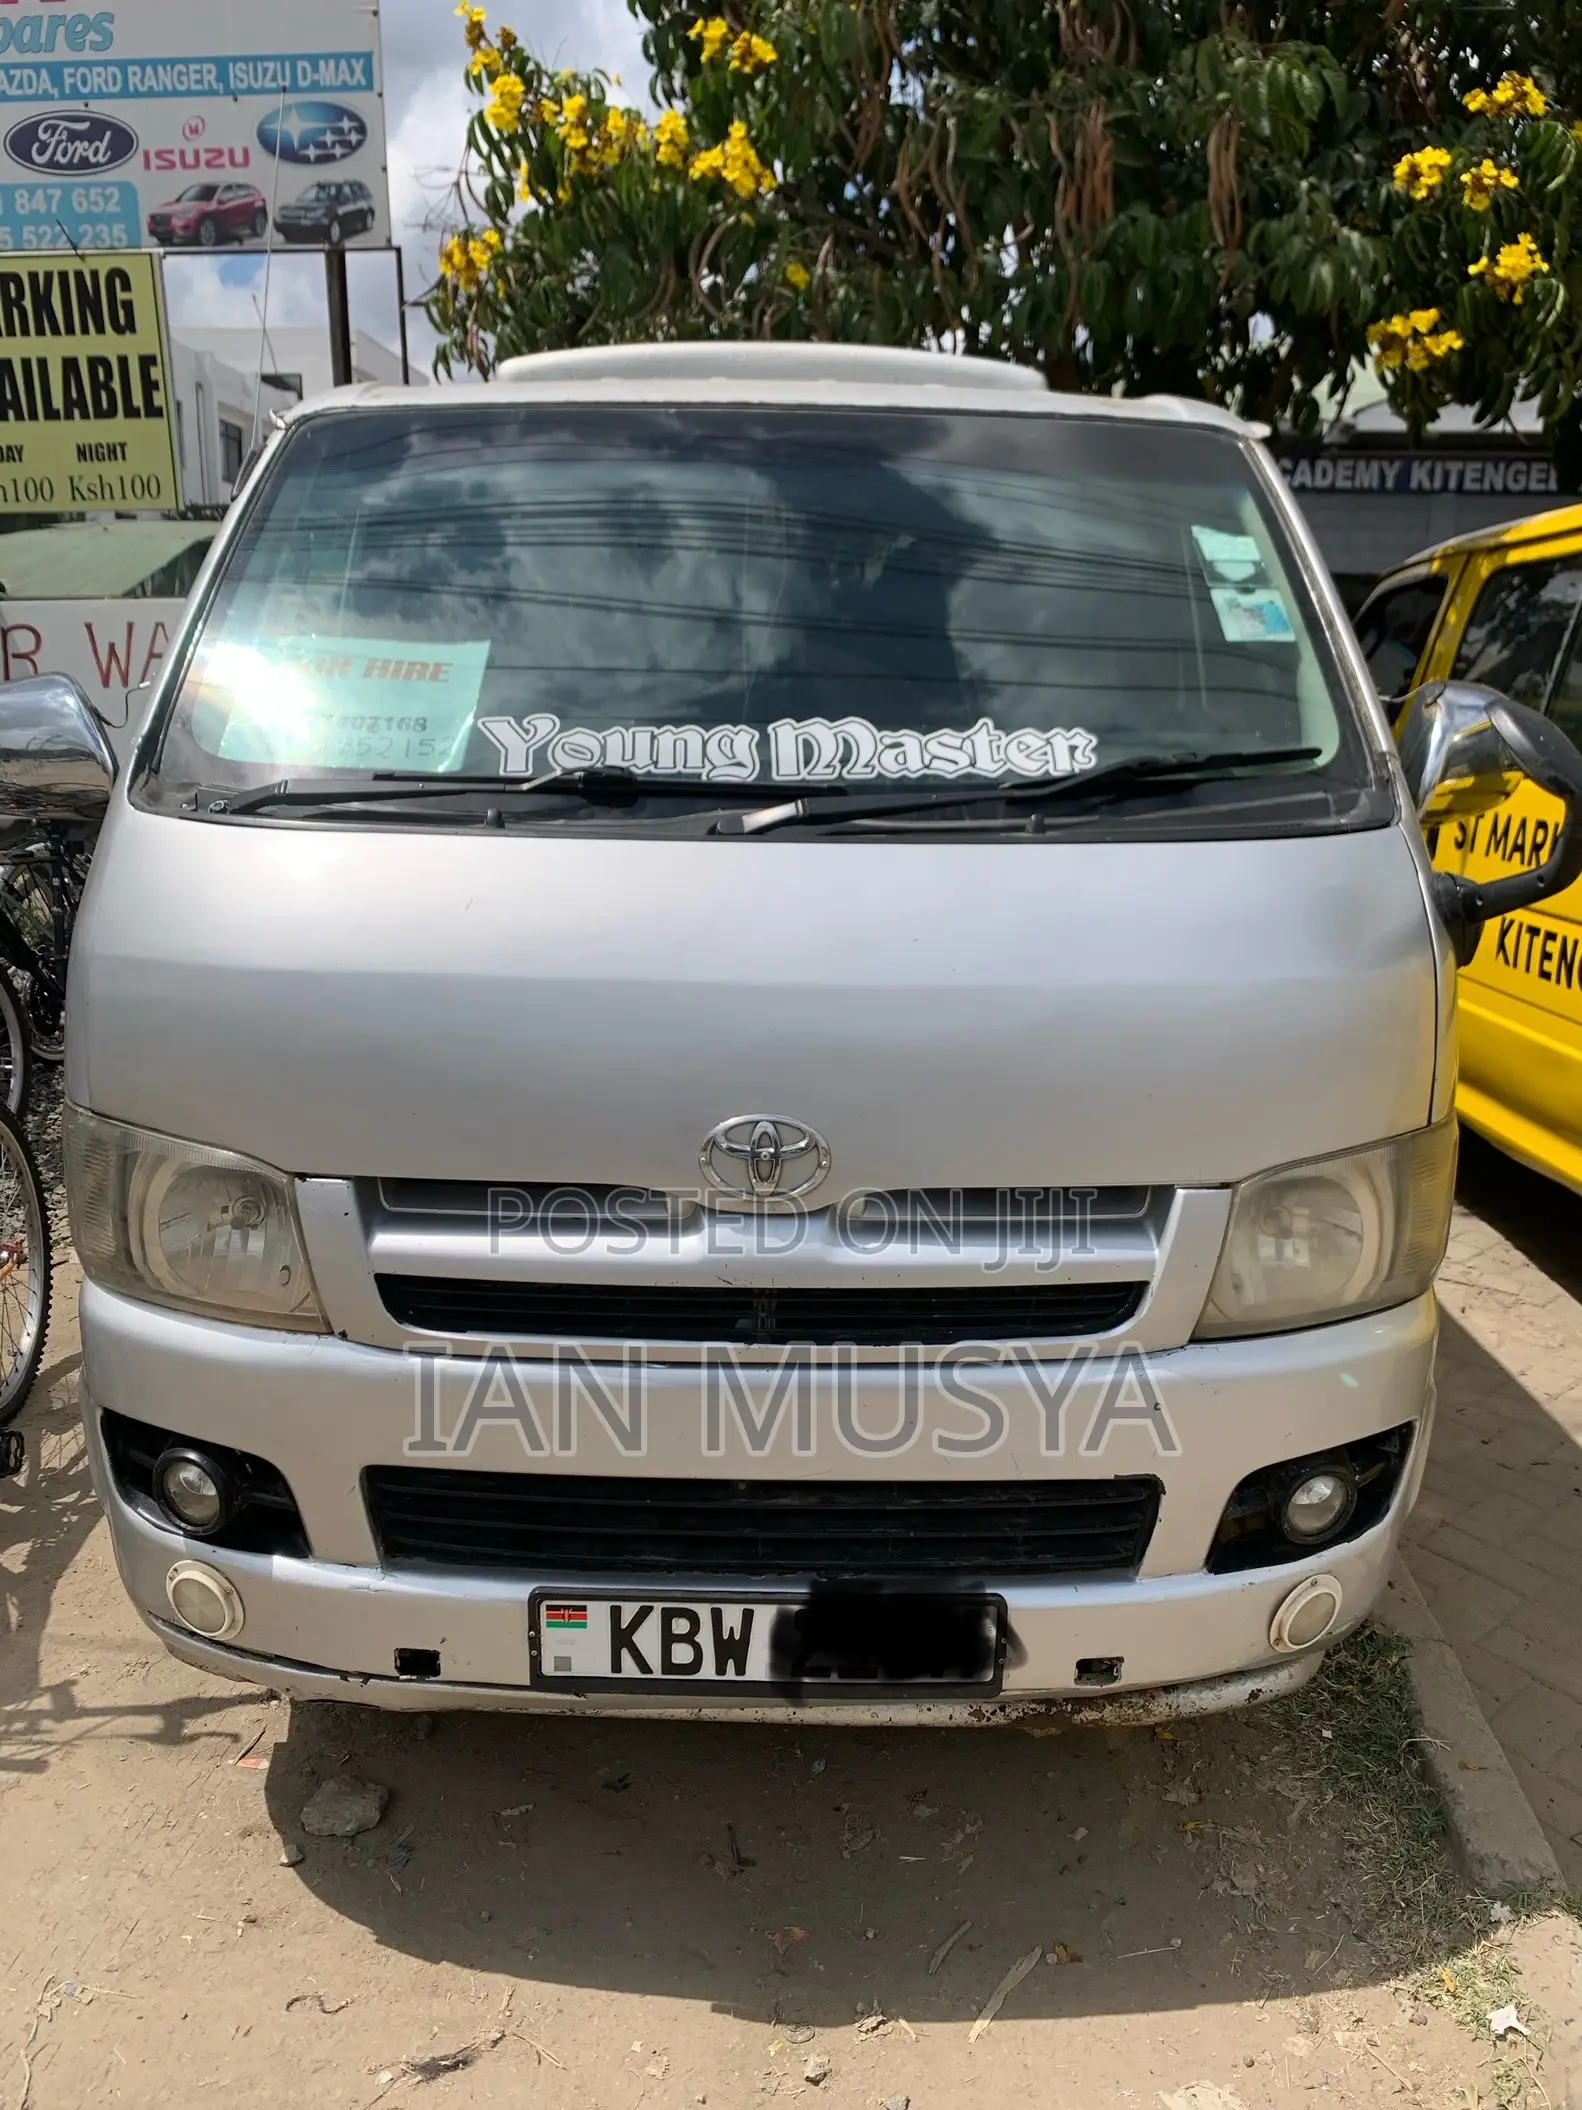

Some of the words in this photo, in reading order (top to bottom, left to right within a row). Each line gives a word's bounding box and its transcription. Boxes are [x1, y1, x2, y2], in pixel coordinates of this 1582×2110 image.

[63, 65, 122, 94] FORD
[127, 62, 224, 94] RANGER,
[229, 60, 291, 89] ISUZU
[297, 56, 367, 88] D-MAX
[31, 119, 112, 165] Ford
[142, 147, 251, 172] ISUZU
[14, 187, 62, 215] 847
[71, 186, 122, 214] 652
[22, 224, 71, 249] 522
[78, 223, 129, 249] 235
[0, 266, 137, 337] RKING
[76, 441, 128, 463] NIGHT
[68, 473, 161, 501] Ksh100
[363, 658, 454, 683] HIRE
[478, 713, 760, 783] Young
[767, 716, 1098, 781] Master
[1495, 917, 1582, 993] KITEN
[609, 1604, 755, 1677] KBW
